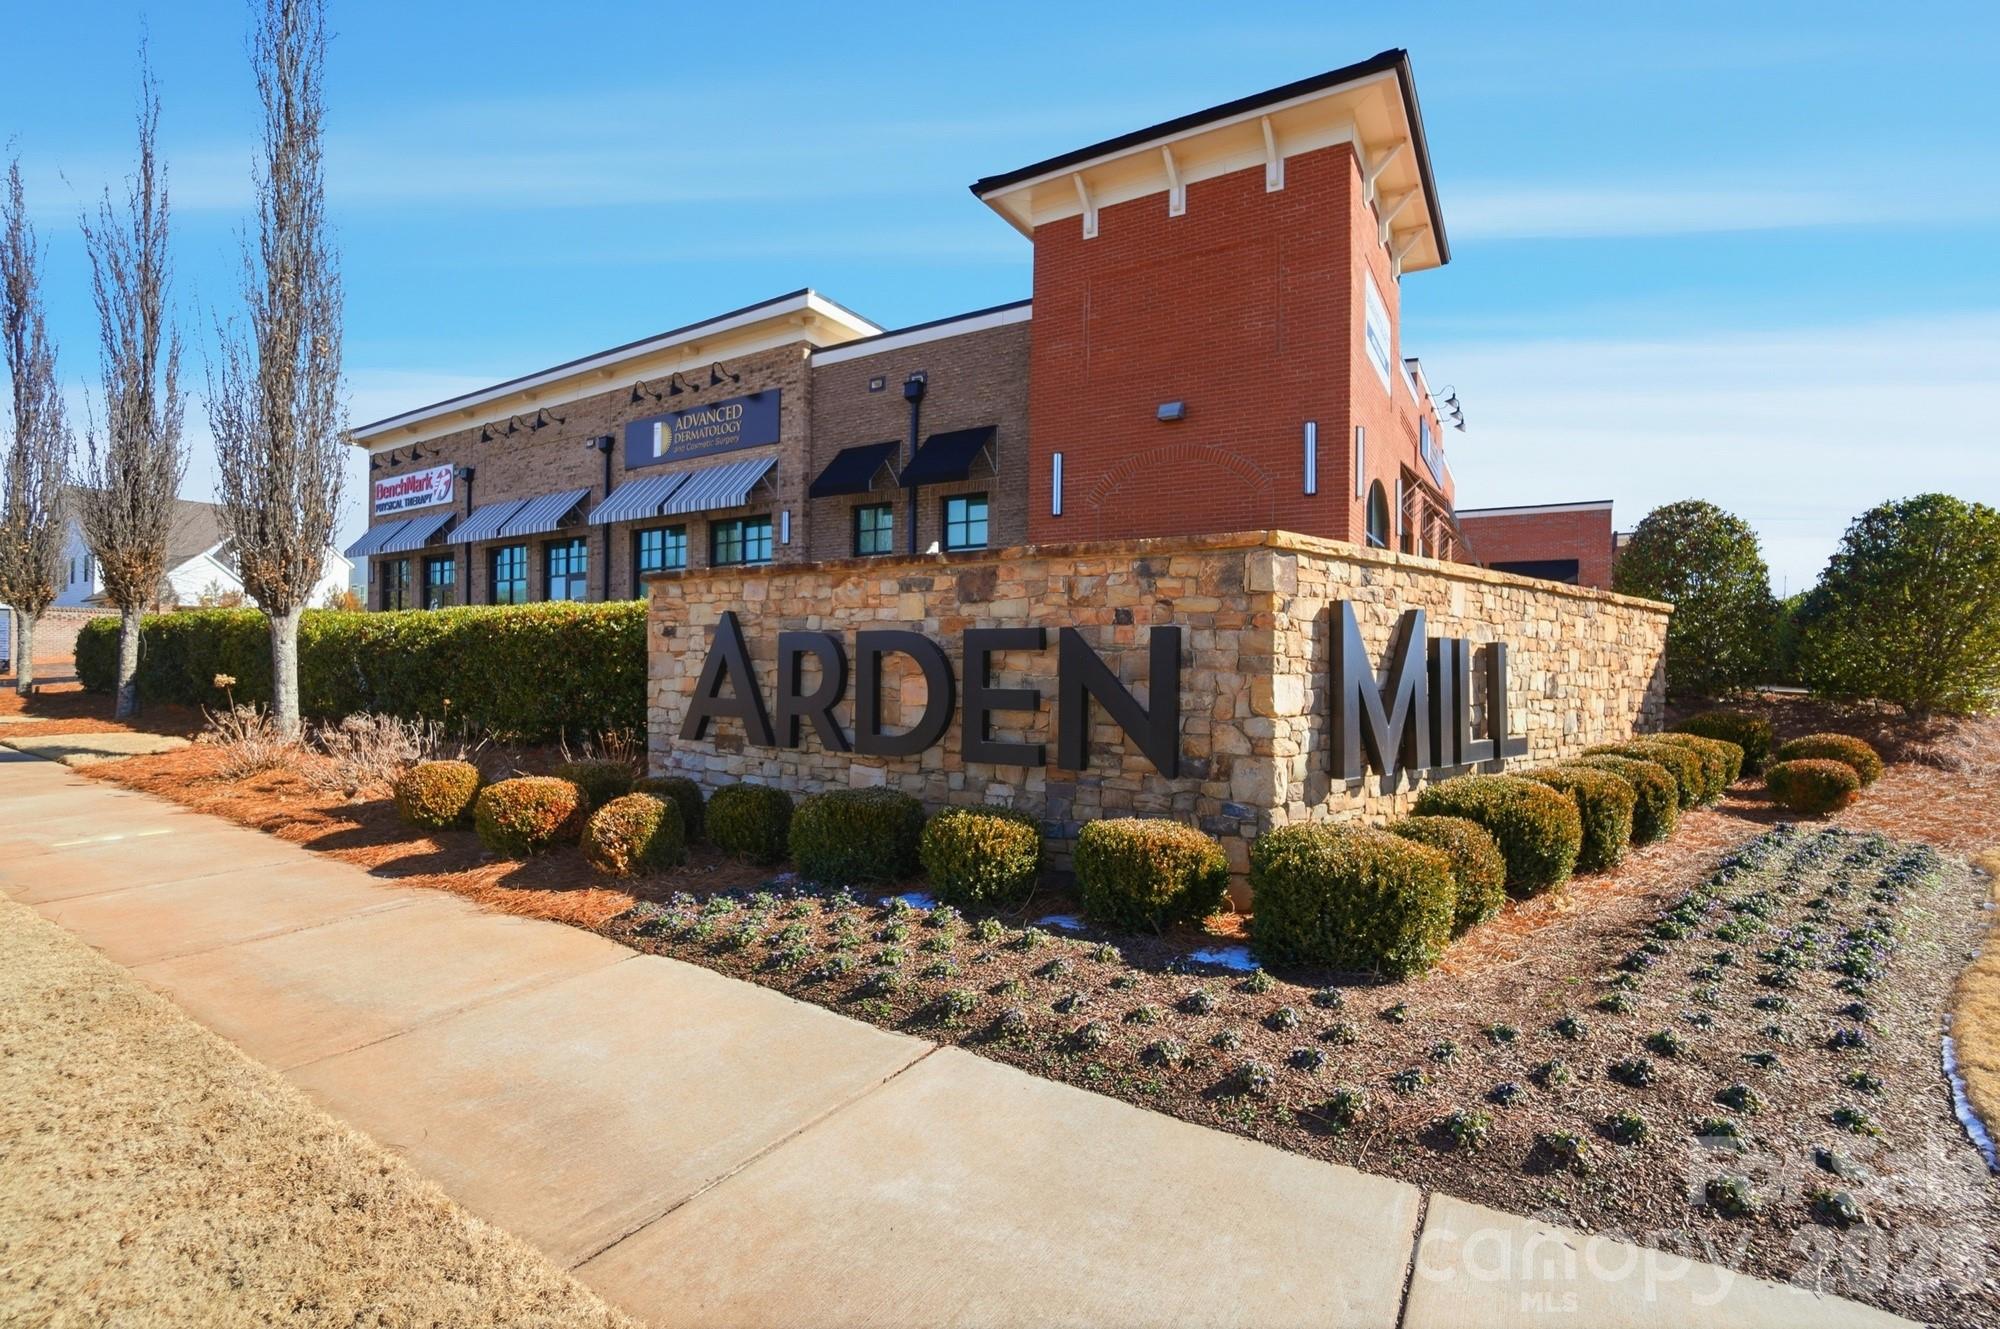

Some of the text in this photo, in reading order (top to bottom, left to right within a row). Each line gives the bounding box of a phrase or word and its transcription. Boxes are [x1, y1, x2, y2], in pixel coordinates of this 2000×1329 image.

[675, 404, 743, 431] ADVANCED
[674, 421, 742, 444] DERMATOLOGY
[715, 435, 740, 447] Surgery
[376, 473, 433, 500] BenchMark
[376, 493, 433, 513] PHYSICAL THERAPY
[678, 600, 1528, 780] ARDEN MILL
